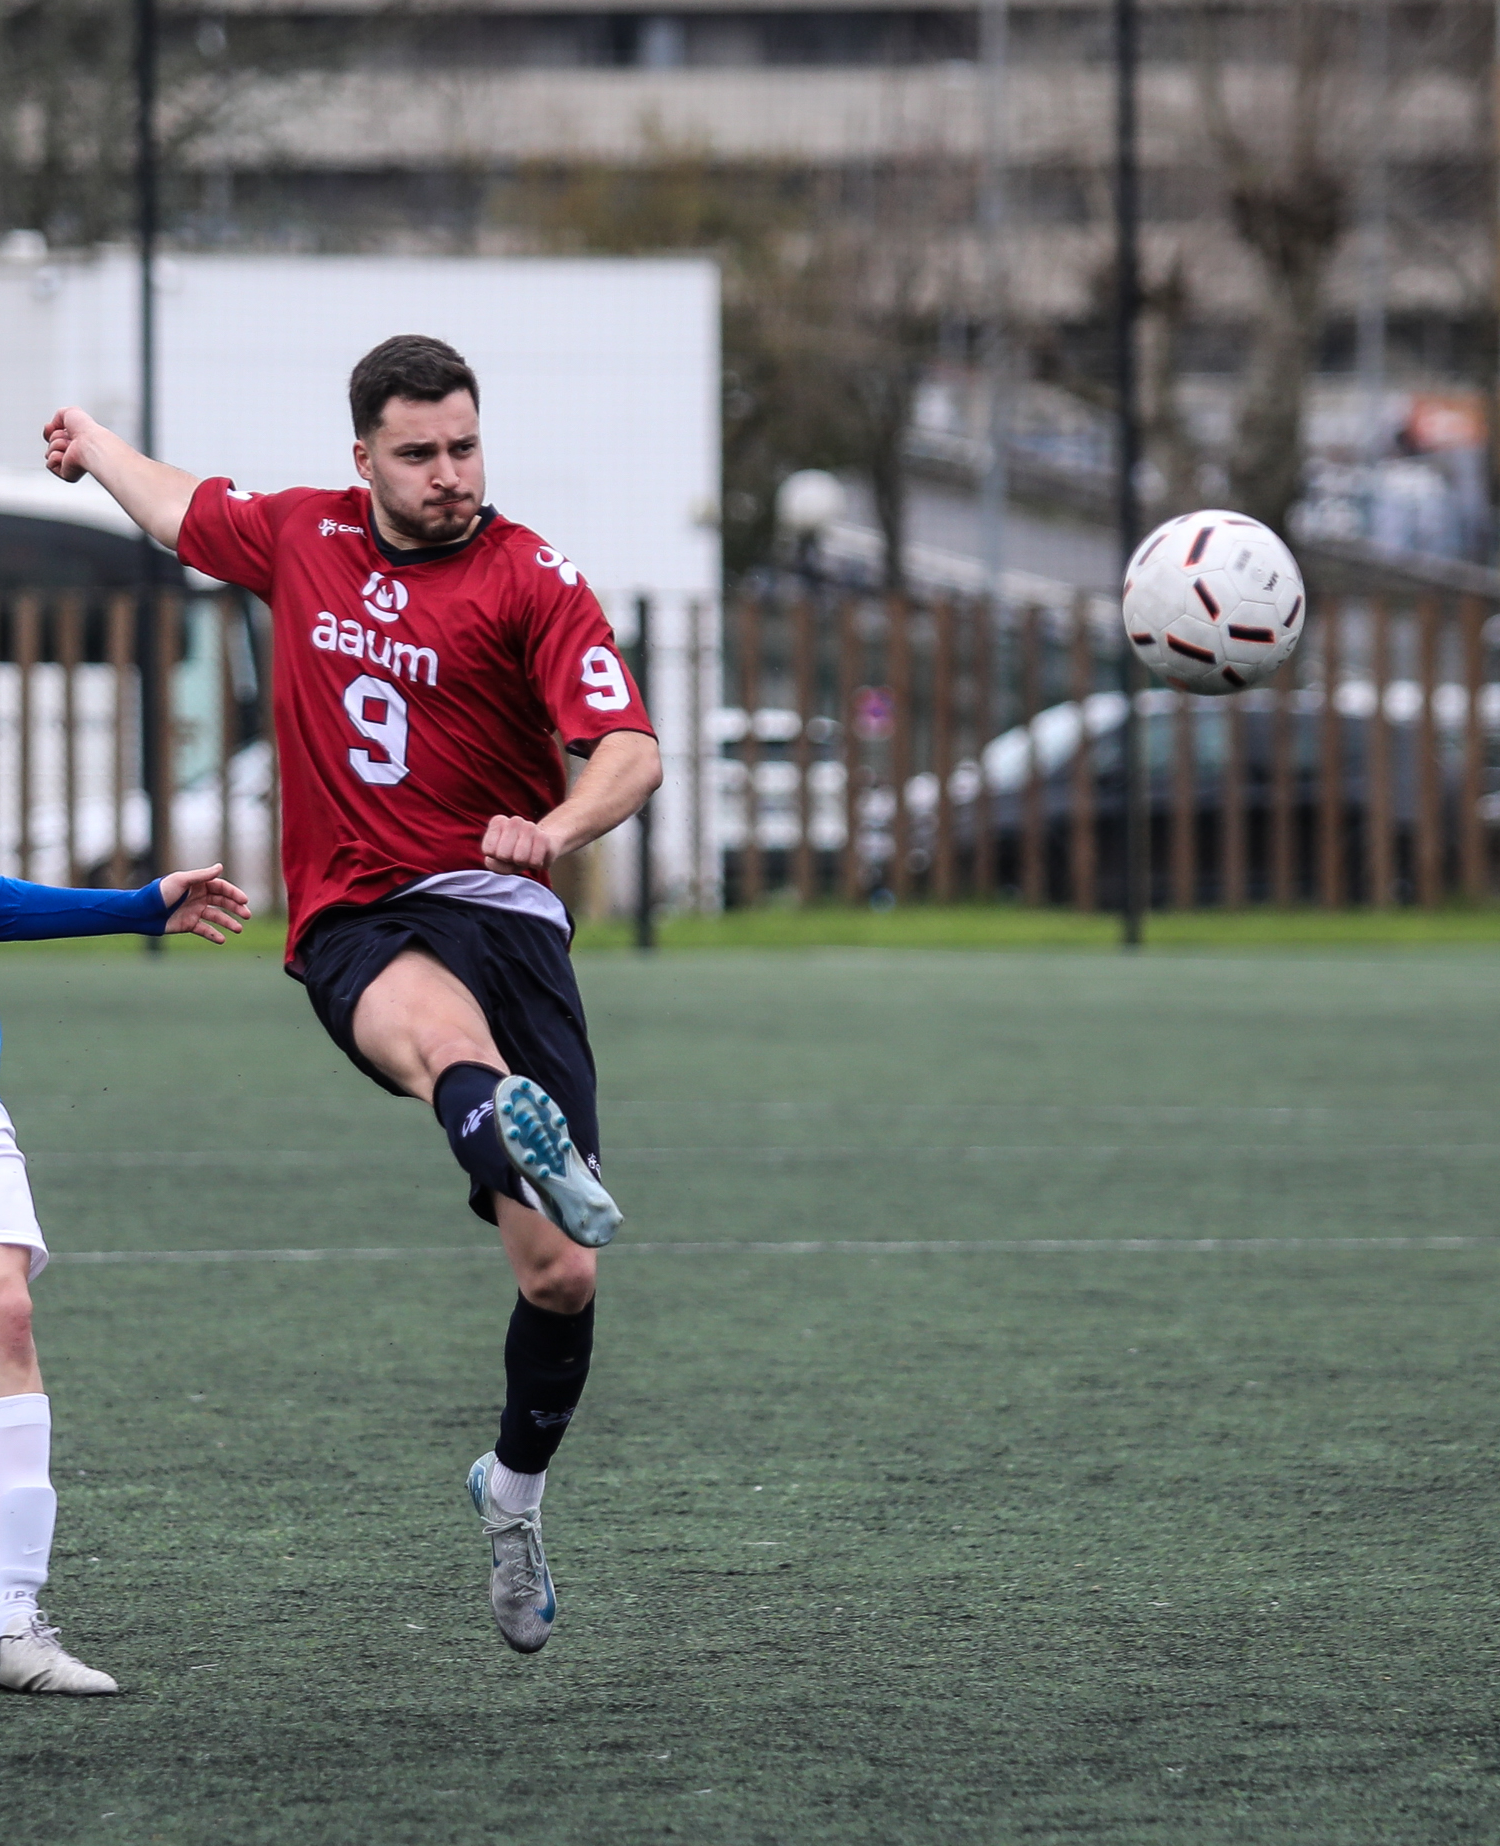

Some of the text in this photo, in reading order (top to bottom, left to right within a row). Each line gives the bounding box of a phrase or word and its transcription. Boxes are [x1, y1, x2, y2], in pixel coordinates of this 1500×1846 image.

[311, 610, 438, 687] aaum
[581, 645, 632, 711] 9
[342, 673, 410, 786] 9
